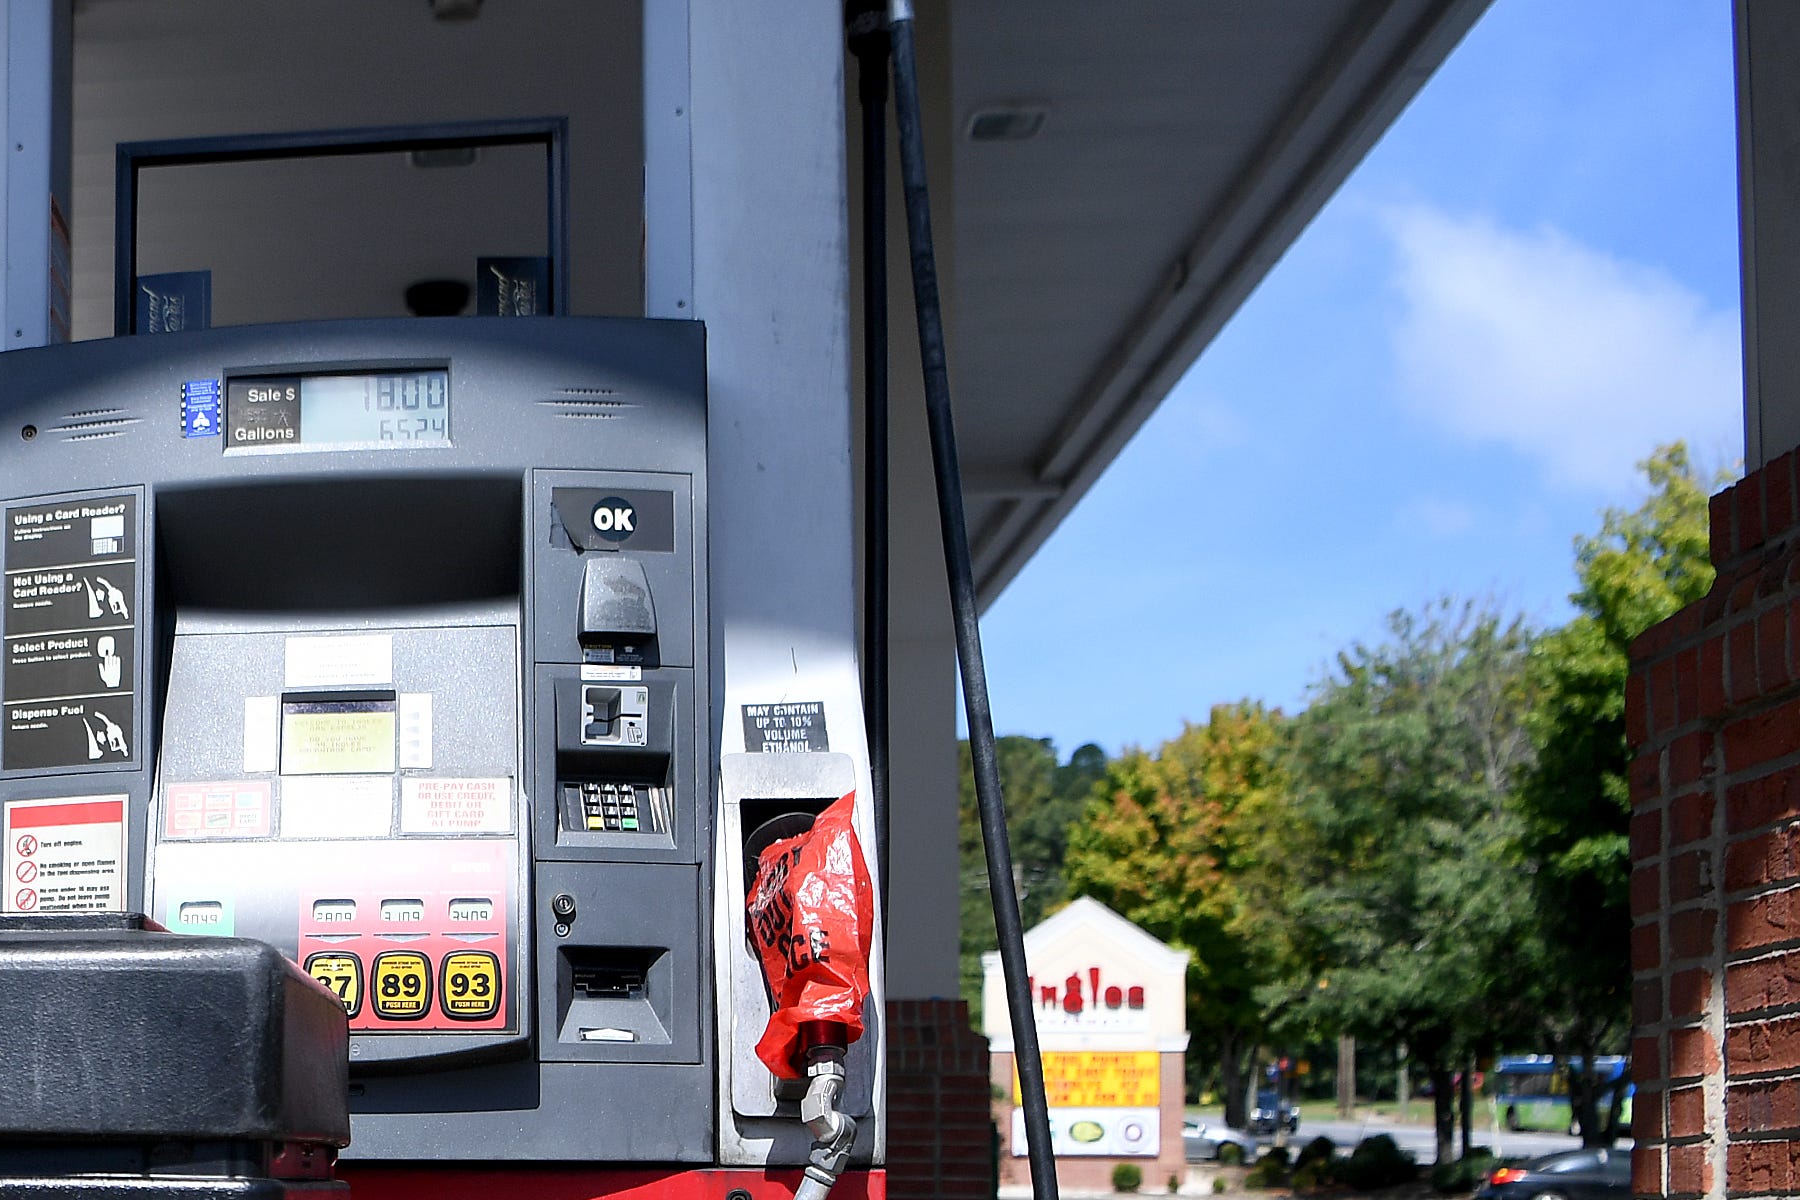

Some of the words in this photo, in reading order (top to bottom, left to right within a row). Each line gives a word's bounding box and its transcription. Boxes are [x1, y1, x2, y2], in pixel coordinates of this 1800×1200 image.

[247, 388, 281, 403] Sale
[234, 427, 295, 442] Gallons
[14, 512, 43, 525] Using
[46, 512, 53, 521] a
[55, 508, 80, 520] Card
[81, 504, 126, 517] Reader?
[593, 507, 634, 531] OK
[13, 576, 32, 587] Not
[34, 573, 64, 585] Using
[66, 573, 74, 581] a
[13, 586, 38, 599] Card
[39, 582, 82, 596] Reader?
[12, 641, 46, 654] Select
[47, 637, 89, 650] Product
[11, 707, 59, 721] Dispense
[60, 704, 84, 716] Fuel
[746, 705, 770, 717] MAY
[773, 703, 819, 716] CONTAIN
[756, 717, 770, 729] UP
[773, 716, 786, 728] TO
[790, 715, 812, 728] 10%
[764, 729, 808, 741] VOLUME
[762, 740, 812, 753] ETHANOL
[418, 782, 464, 791] PRE-PAY
[466, 782, 496, 791] CASH
[418, 792, 432, 801] OR
[434, 792, 454, 800] USE
[430, 801, 463, 809] DEBIT
[465, 801, 482, 809] OR
[454, 810, 485, 819] CARD
[448, 819, 482, 827] PUMP
[48, 861, 72, 869] smoking
[381, 973, 421, 997] 89
[450, 972, 491, 997] 93
[1029, 967, 1144, 1014] ngles
[385, 1001, 400, 1009] PUSH
[401, 1001, 416, 1009] HERE
